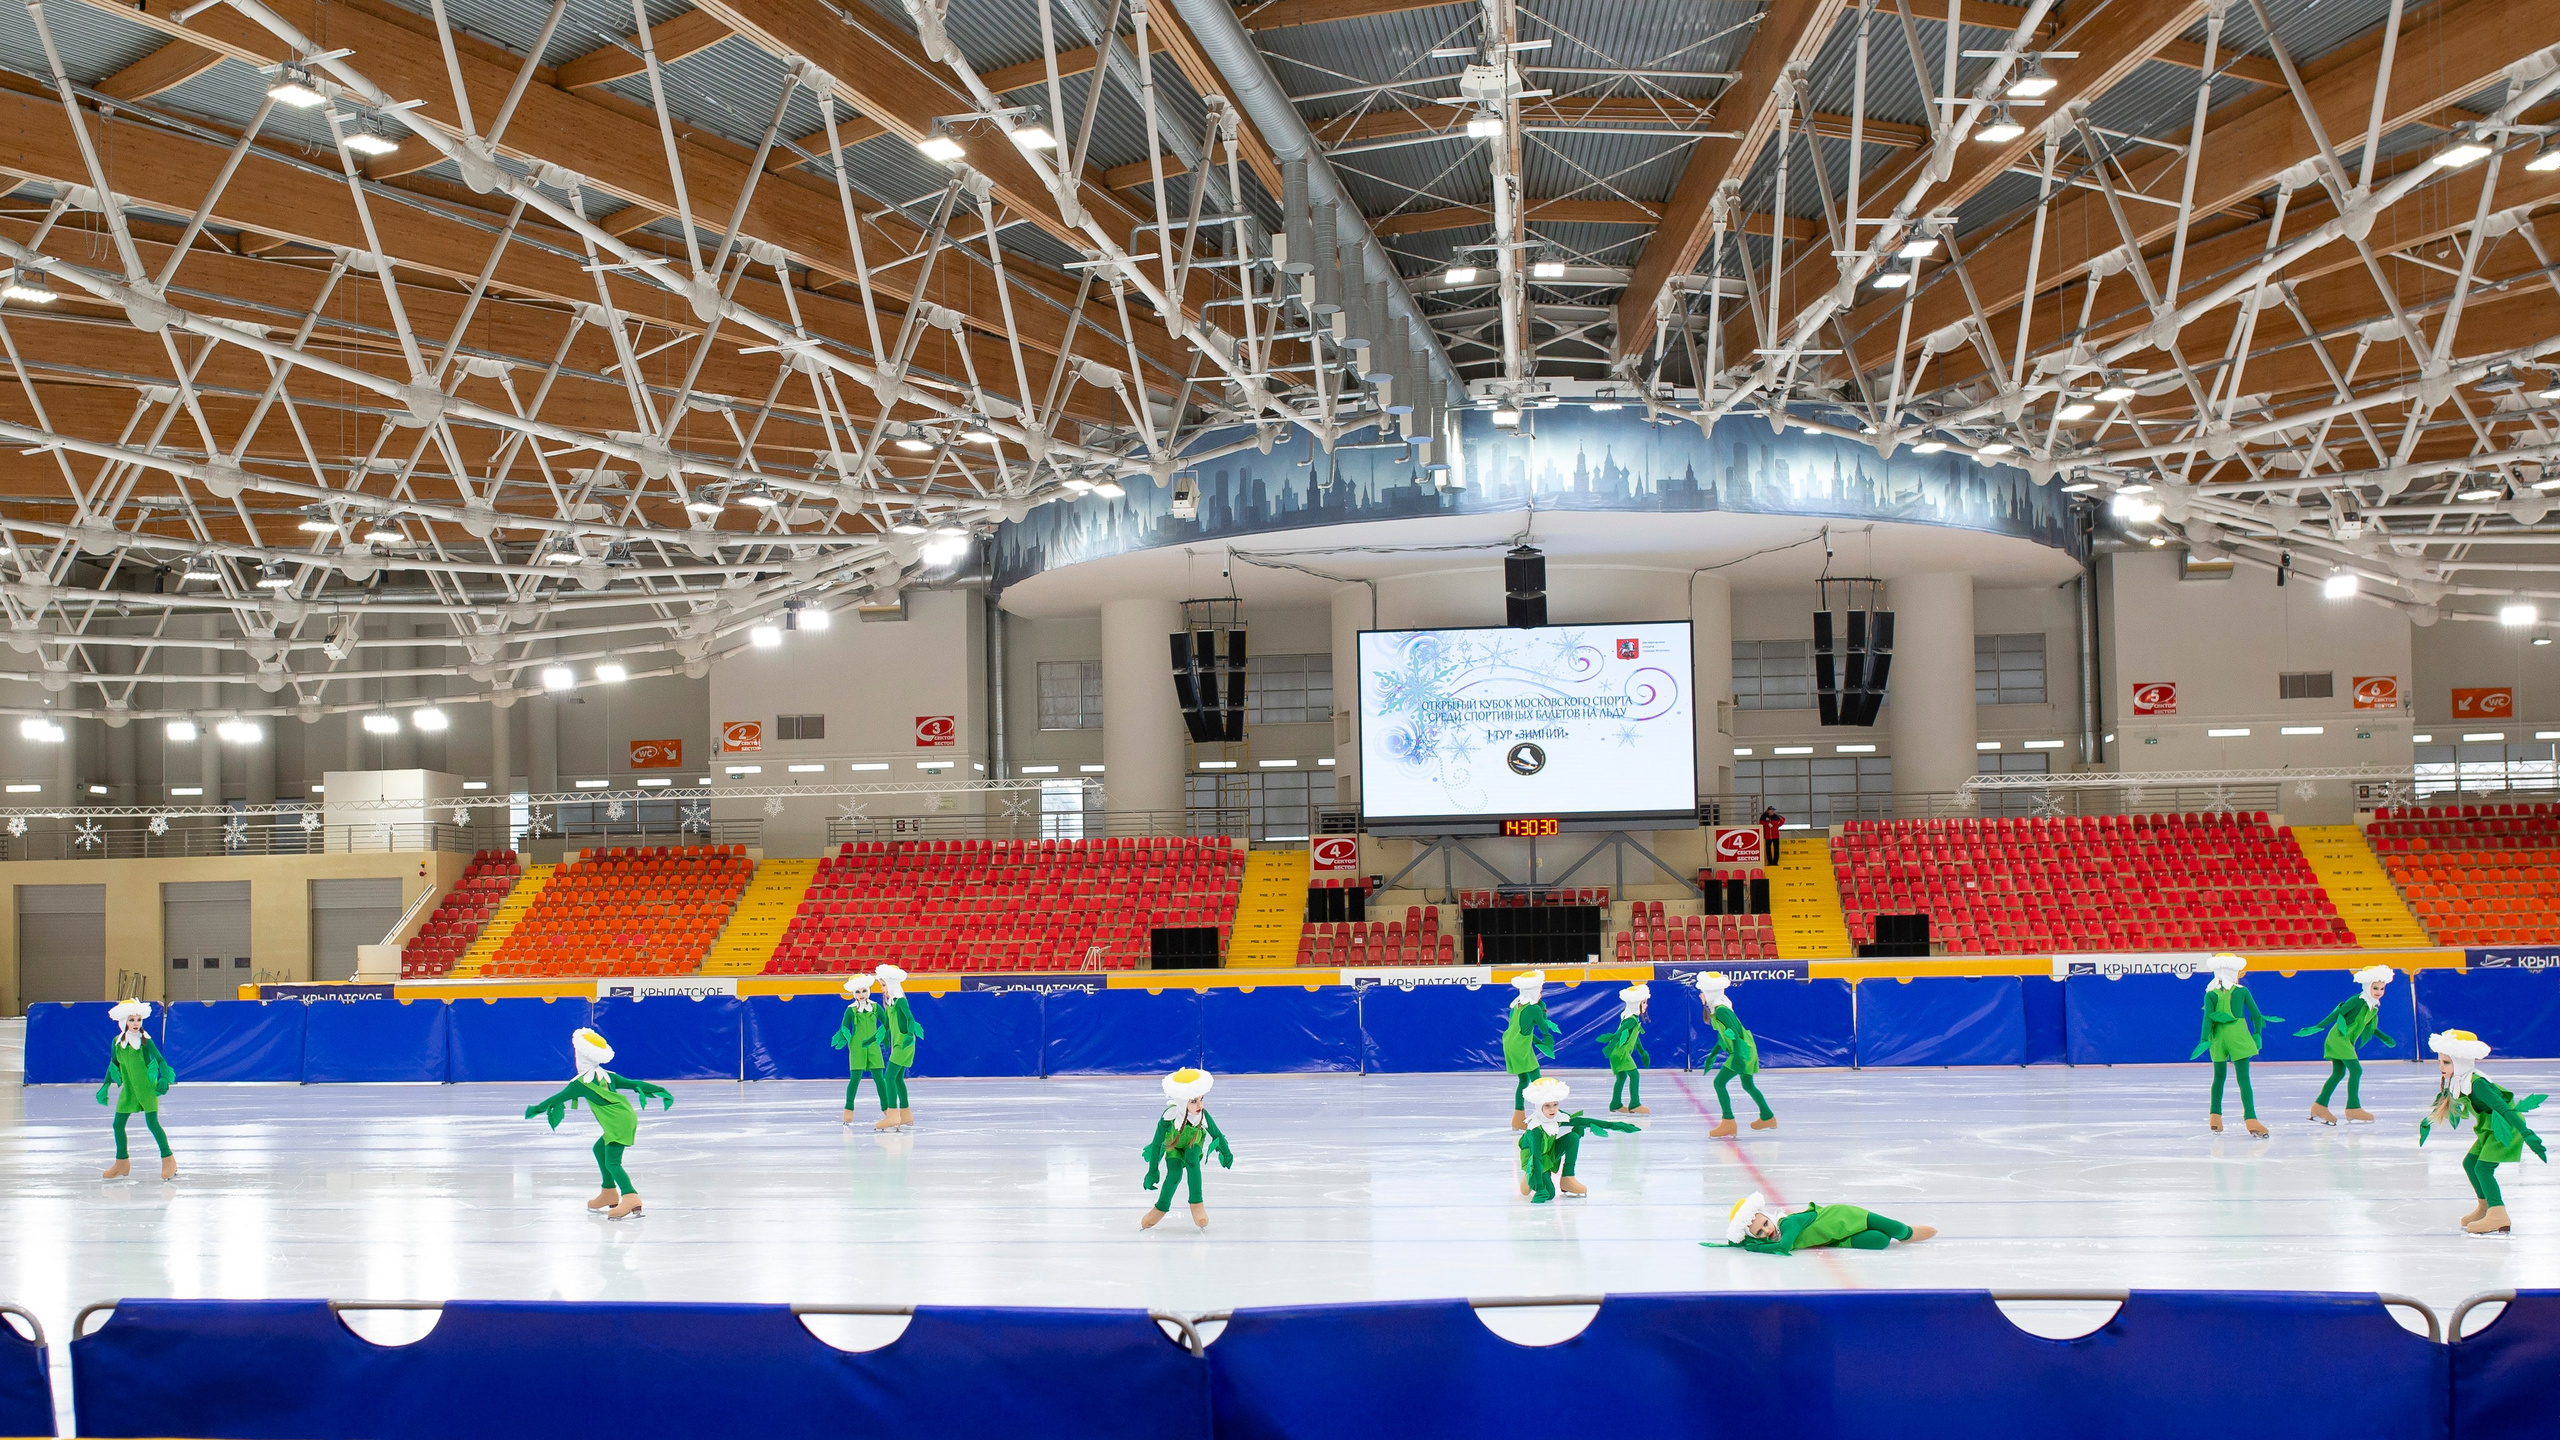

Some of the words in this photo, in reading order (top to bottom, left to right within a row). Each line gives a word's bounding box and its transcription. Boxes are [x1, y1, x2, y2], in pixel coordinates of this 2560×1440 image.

[2150, 689, 2160, 702] 5
[2370, 682, 2381, 696] 6
[1421, 699, 1477, 712] ОТКРЫТЫЙ
[1479, 698, 1513, 710] КУБОК
[1514, 696, 1591, 709] МОСКОВСКОГО
[1592, 695, 1633, 707] СПОРТА
[2488, 698, 2505, 707] WC
[1428, 712, 1462, 722] СРЕДИ
[1464, 709, 1533, 721] СПОРТИВНЫХ
[1535, 708, 1581, 720] БАЛЕТОВ
[1582, 708, 1597, 718] НА
[1598, 707, 1627, 718] ЛЬДУ
[738, 727, 747, 740] 2
[932, 722, 941, 735] 3
[1494, 730, 1513, 740] ТУР
[638, 749, 654, 759] WC
[1732, 835, 1744, 849] 4
[1330, 844, 1341, 858] 4
[2103, 963, 2198, 974] КРЫЛАТСКОЕ
